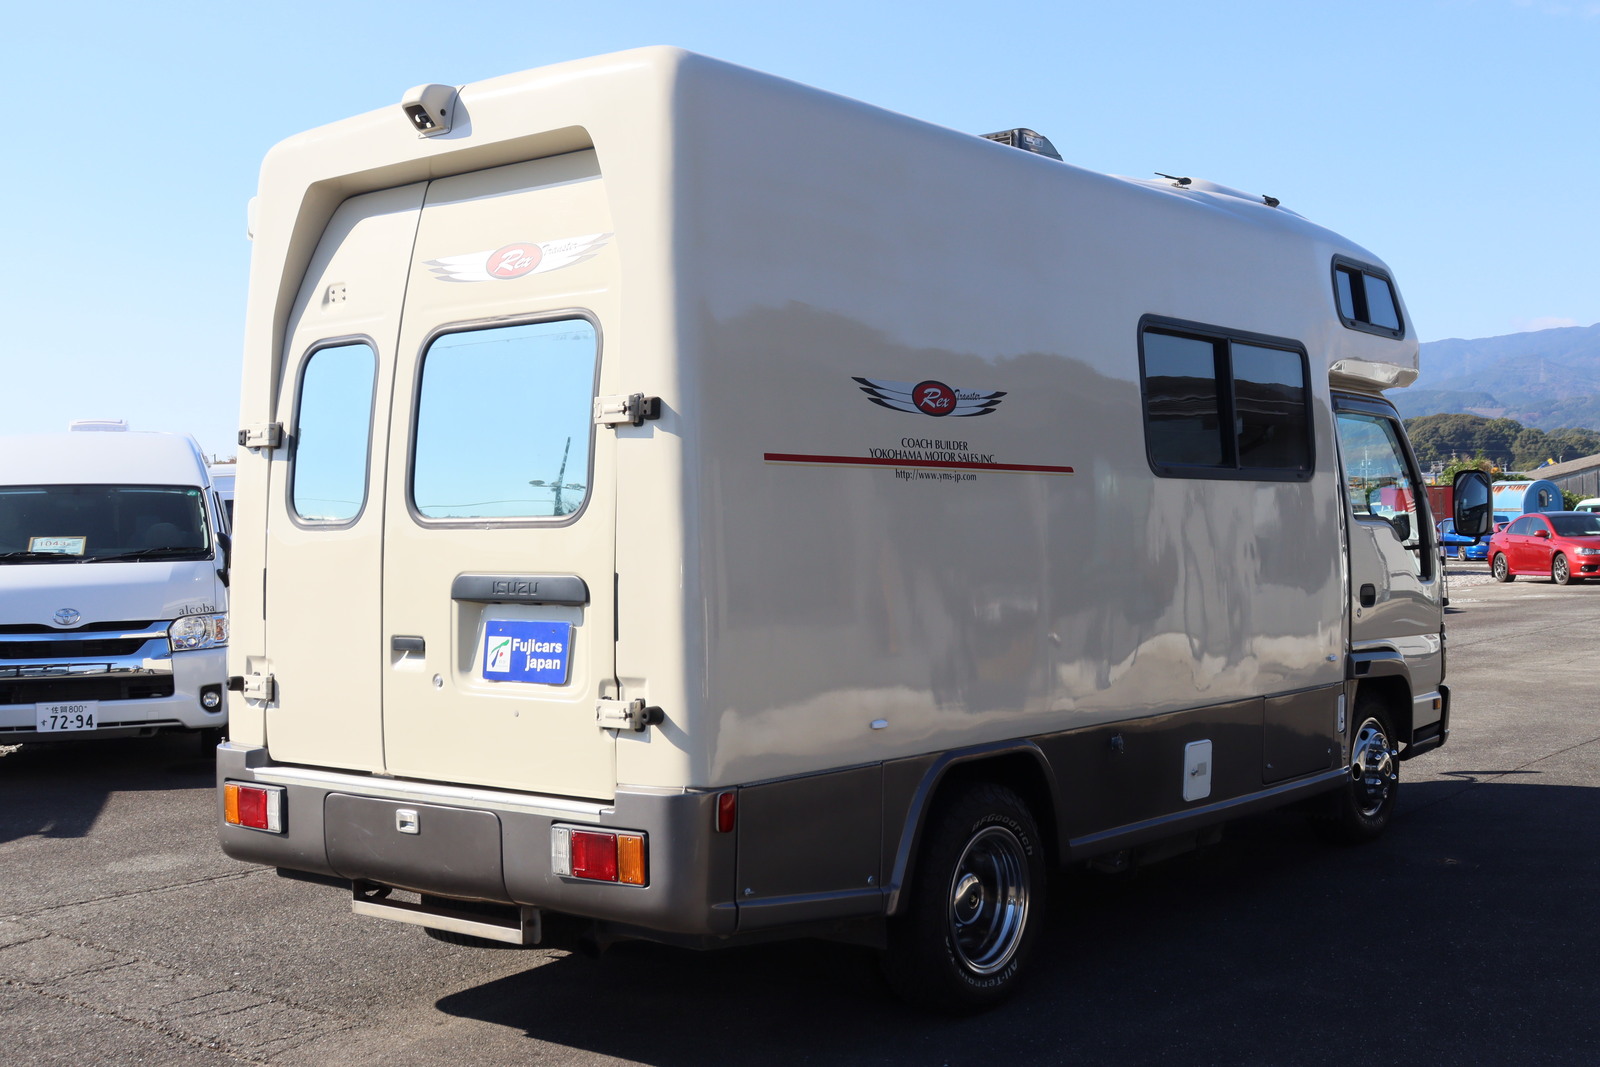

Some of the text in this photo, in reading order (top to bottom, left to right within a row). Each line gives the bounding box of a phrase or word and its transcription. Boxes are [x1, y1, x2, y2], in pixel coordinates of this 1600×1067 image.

[494, 249, 534, 273] Rex
[920, 387, 950, 409] Rex
[901, 437, 969, 451] COACH BUILDER
[868, 448, 923, 461] YOKOHAMA
[925, 451, 956, 463] MOTOR
[895, 469, 978, 483] http://www.yms-jp.com
[492, 581, 539, 596] ISUZU
[179, 603, 215, 615] alcoba
[512, 638, 563, 655] Fujicars
[50, 714, 94, 730] 72-94
